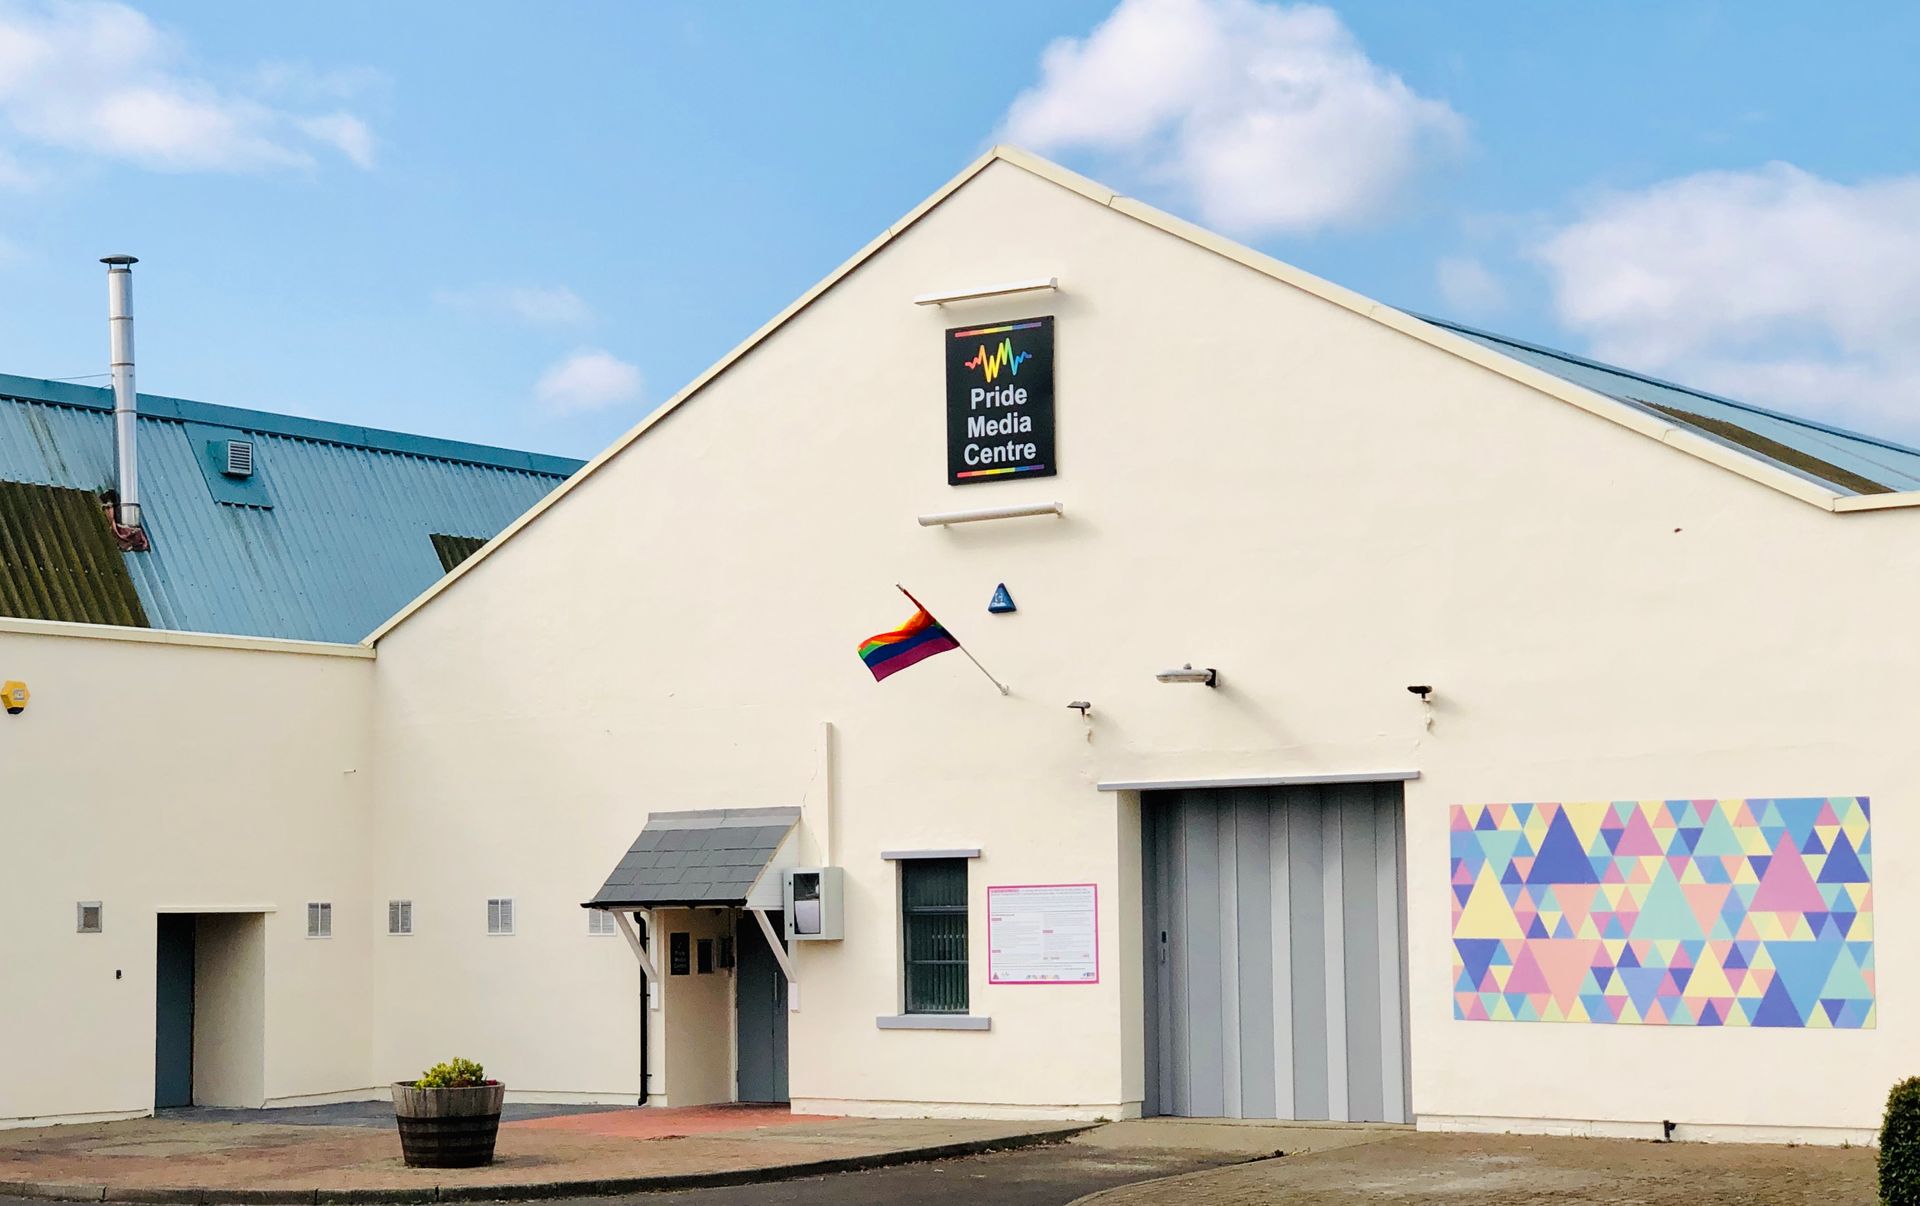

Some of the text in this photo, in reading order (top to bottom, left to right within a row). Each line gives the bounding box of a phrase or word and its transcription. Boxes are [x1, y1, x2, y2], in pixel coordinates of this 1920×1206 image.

[970, 384, 1028, 410] Pride
[967, 412, 1032, 438] Media
[964, 441, 1037, 466] Centre
